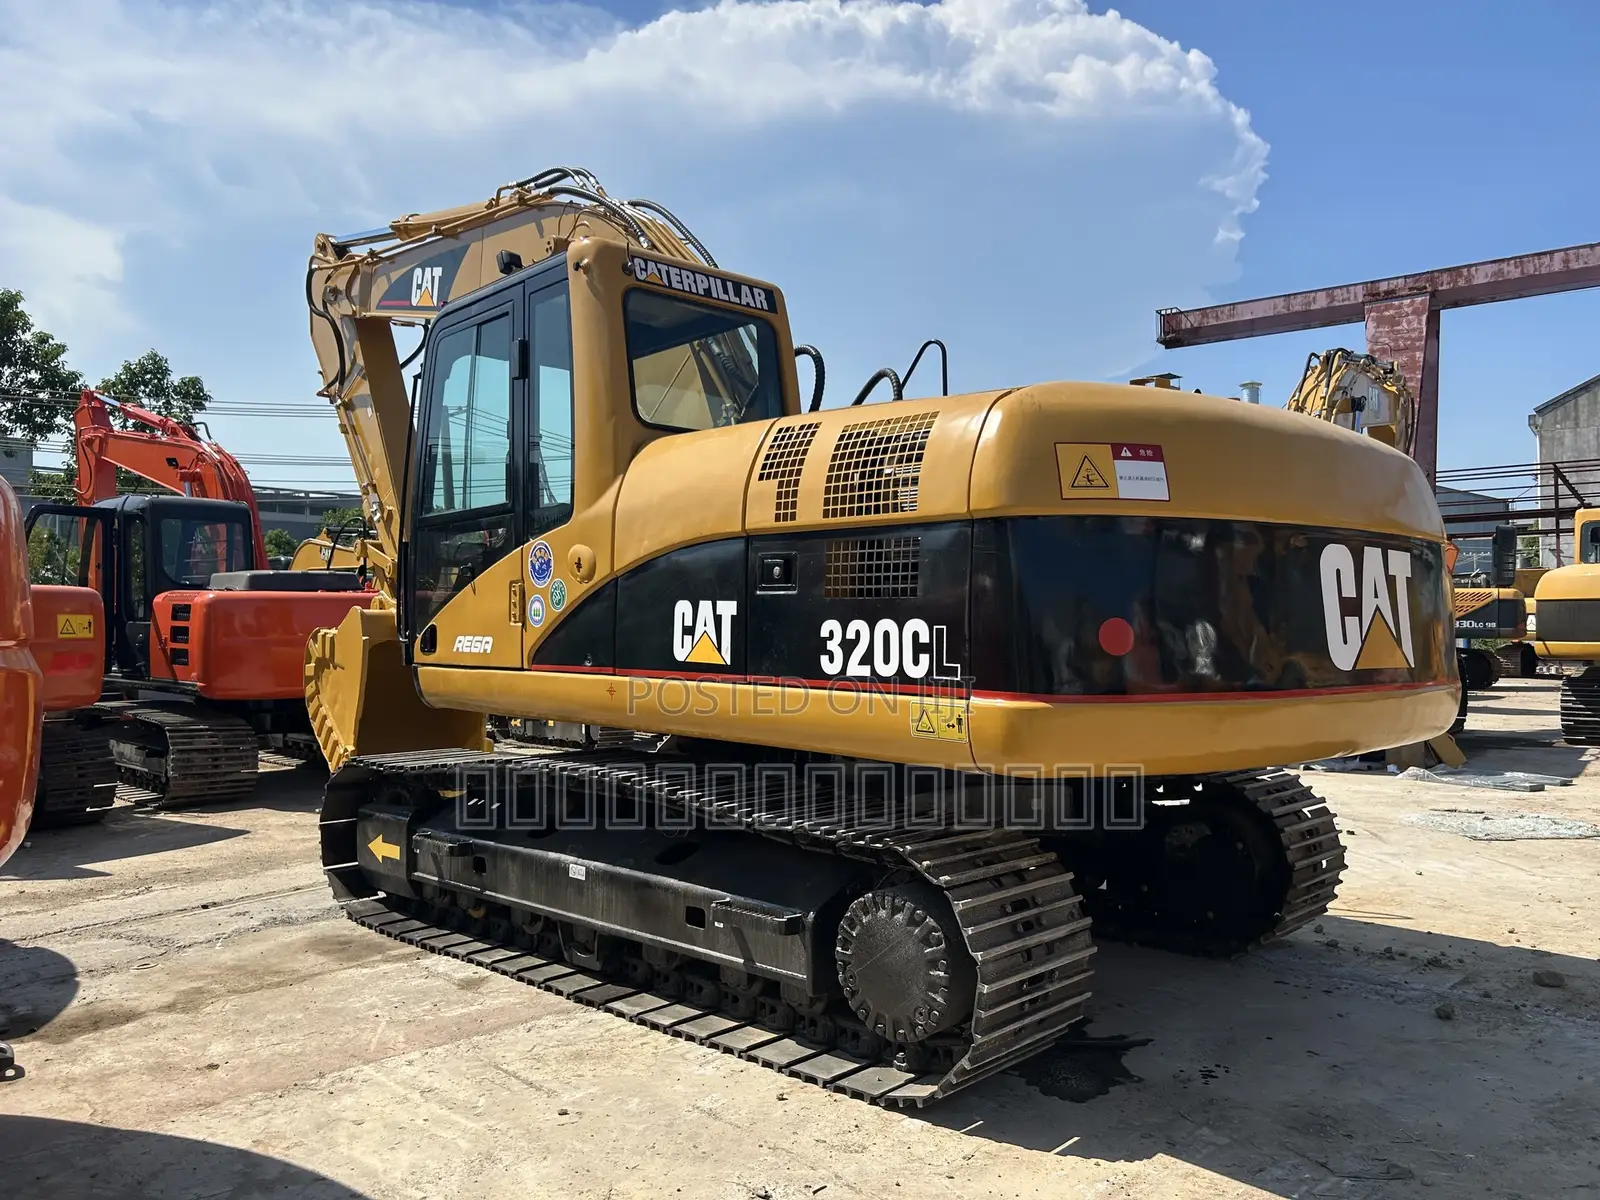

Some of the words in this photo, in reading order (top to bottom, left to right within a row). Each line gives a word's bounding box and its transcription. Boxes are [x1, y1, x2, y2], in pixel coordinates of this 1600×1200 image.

[411, 266, 443, 307] CAT
[633, 256, 769, 311] CATERPILLAR
[673, 600, 738, 666] CAT
[1320, 543, 1415, 671] CAT
